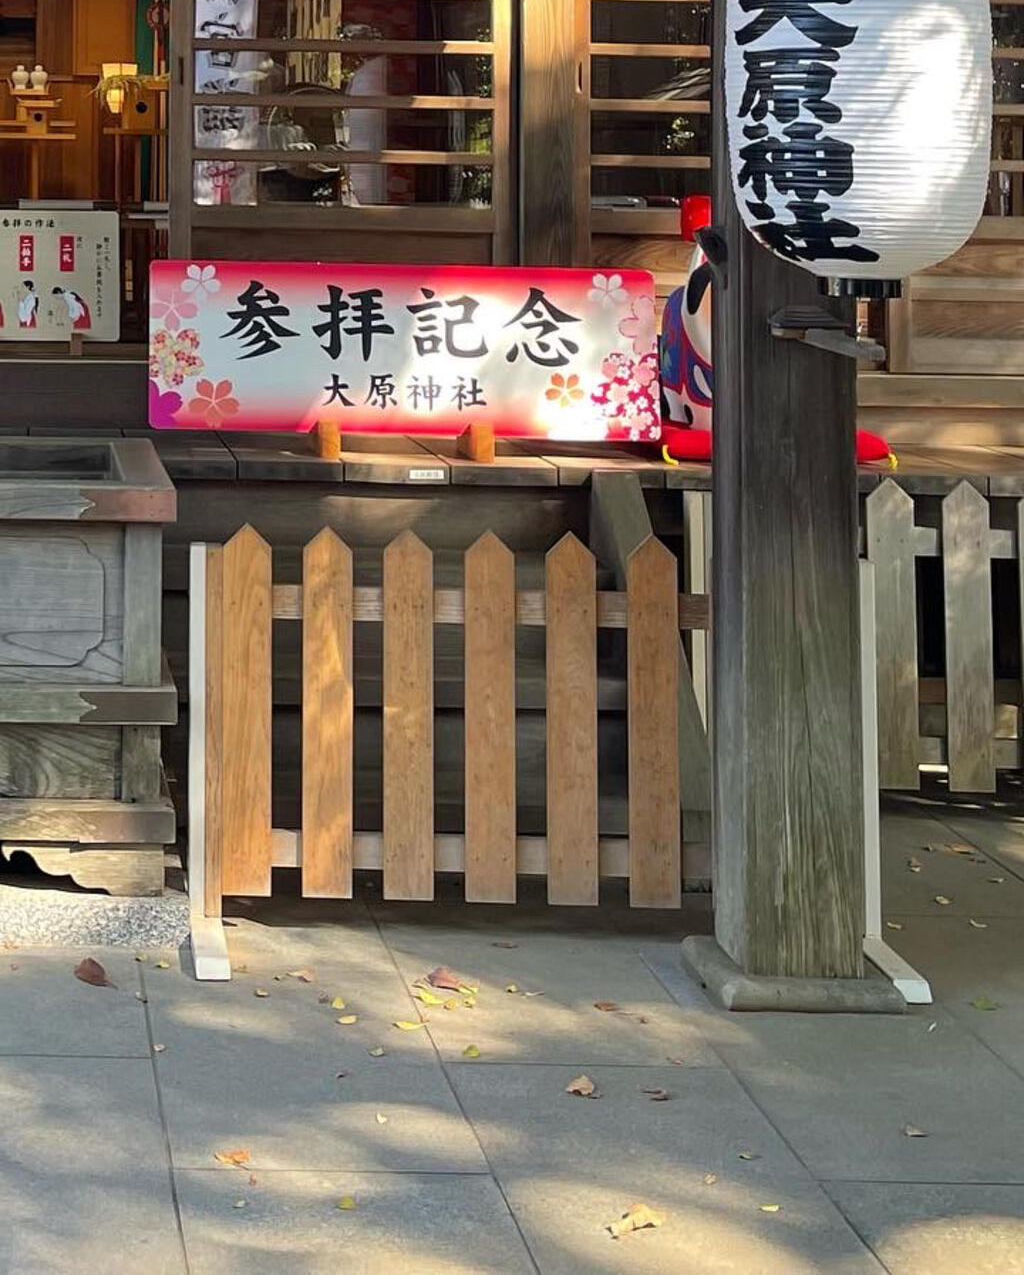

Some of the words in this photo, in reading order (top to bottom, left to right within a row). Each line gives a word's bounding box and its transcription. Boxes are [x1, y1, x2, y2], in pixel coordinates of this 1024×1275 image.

[218, 279, 584, 367] 参拝記念
[322, 373, 488, 412] 大原神社
